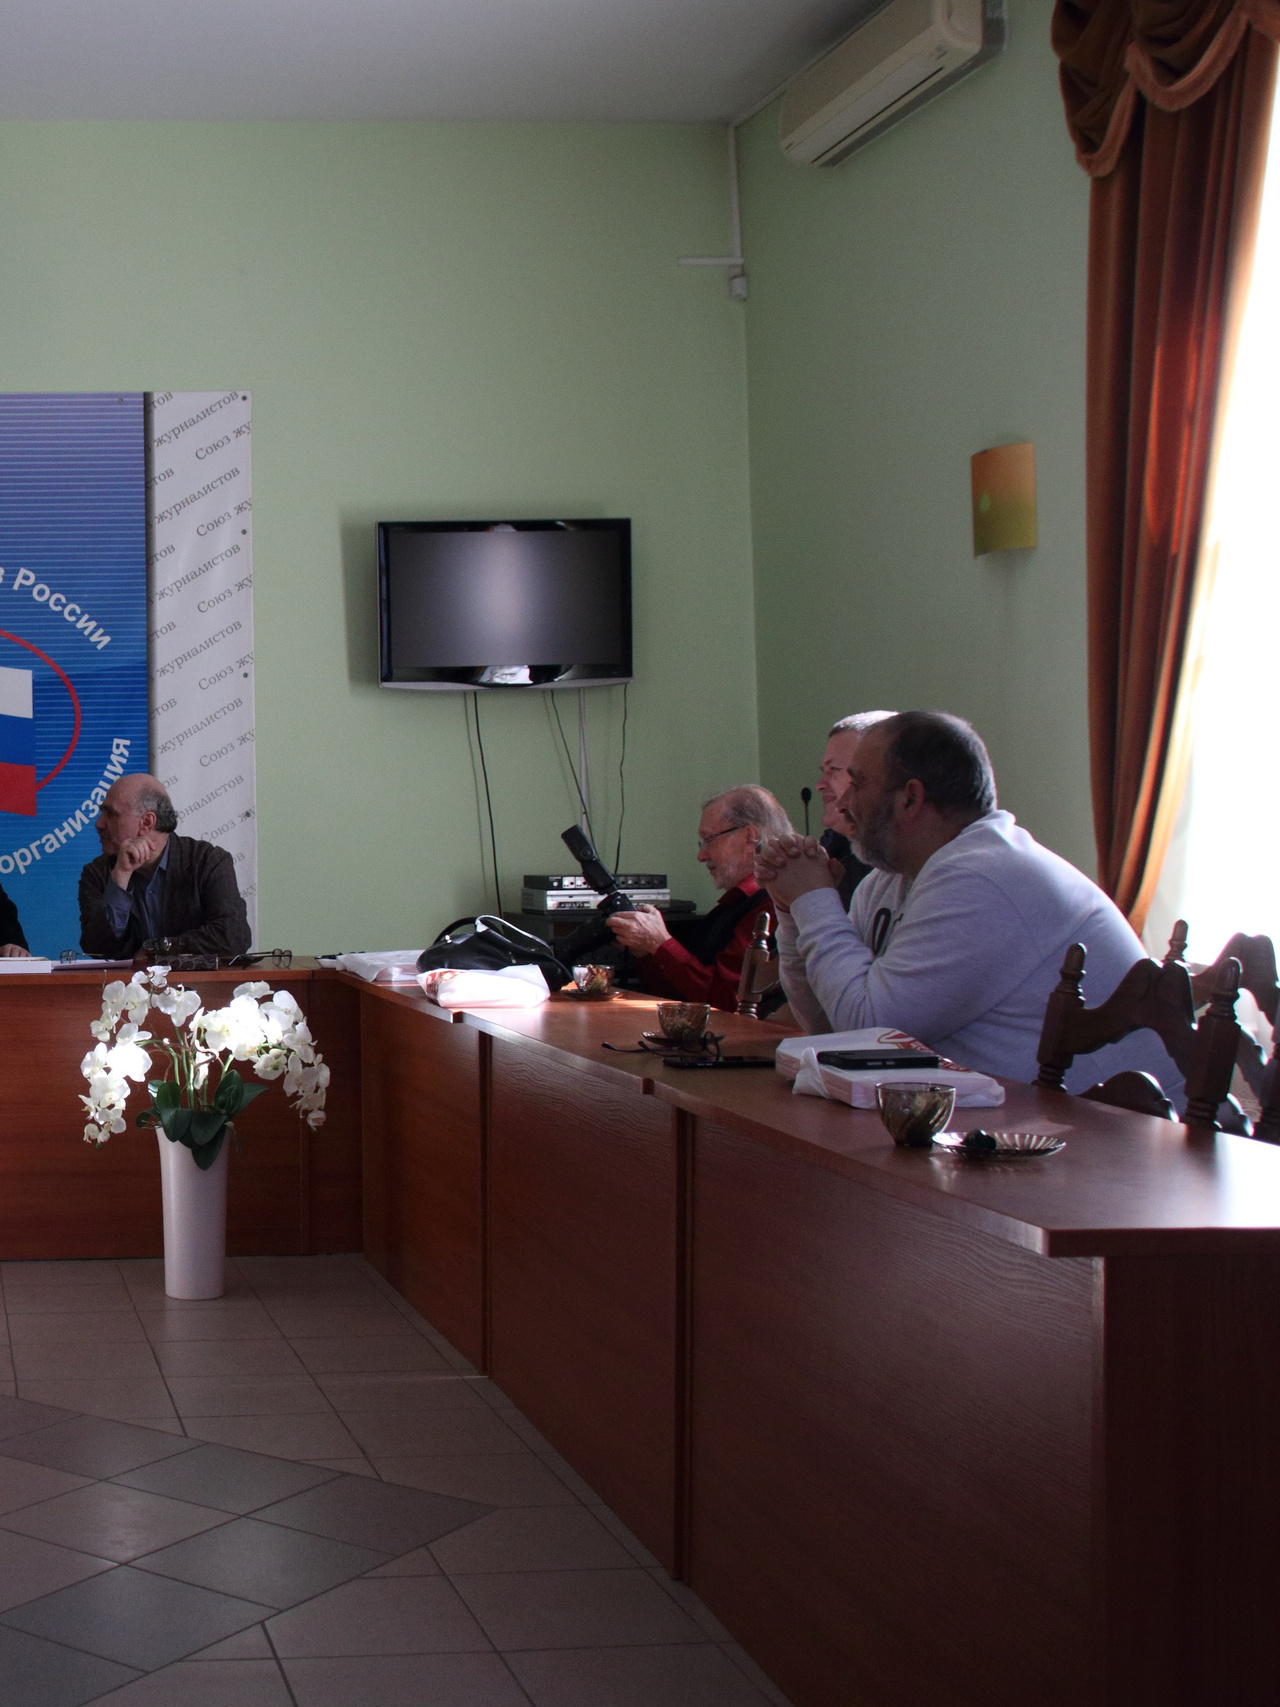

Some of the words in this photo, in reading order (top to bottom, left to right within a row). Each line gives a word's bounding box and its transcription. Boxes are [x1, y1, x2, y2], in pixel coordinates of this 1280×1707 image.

[153, 391, 239, 448] журналистов
[195, 435, 231, 460] Союз
[153, 467, 240, 524] журналистов
[196, 512, 232, 536] Союз
[155, 544, 241, 601] журналистов
[12, 567, 112, 650] России
[197, 589, 233, 613] Союз
[155, 621, 242, 677] журналистов
[198, 666, 234, 690] Союз
[157, 698, 243, 755] журналистов
[199, 743, 235, 767] Союз
[176, 775, 244, 823] рналистов
